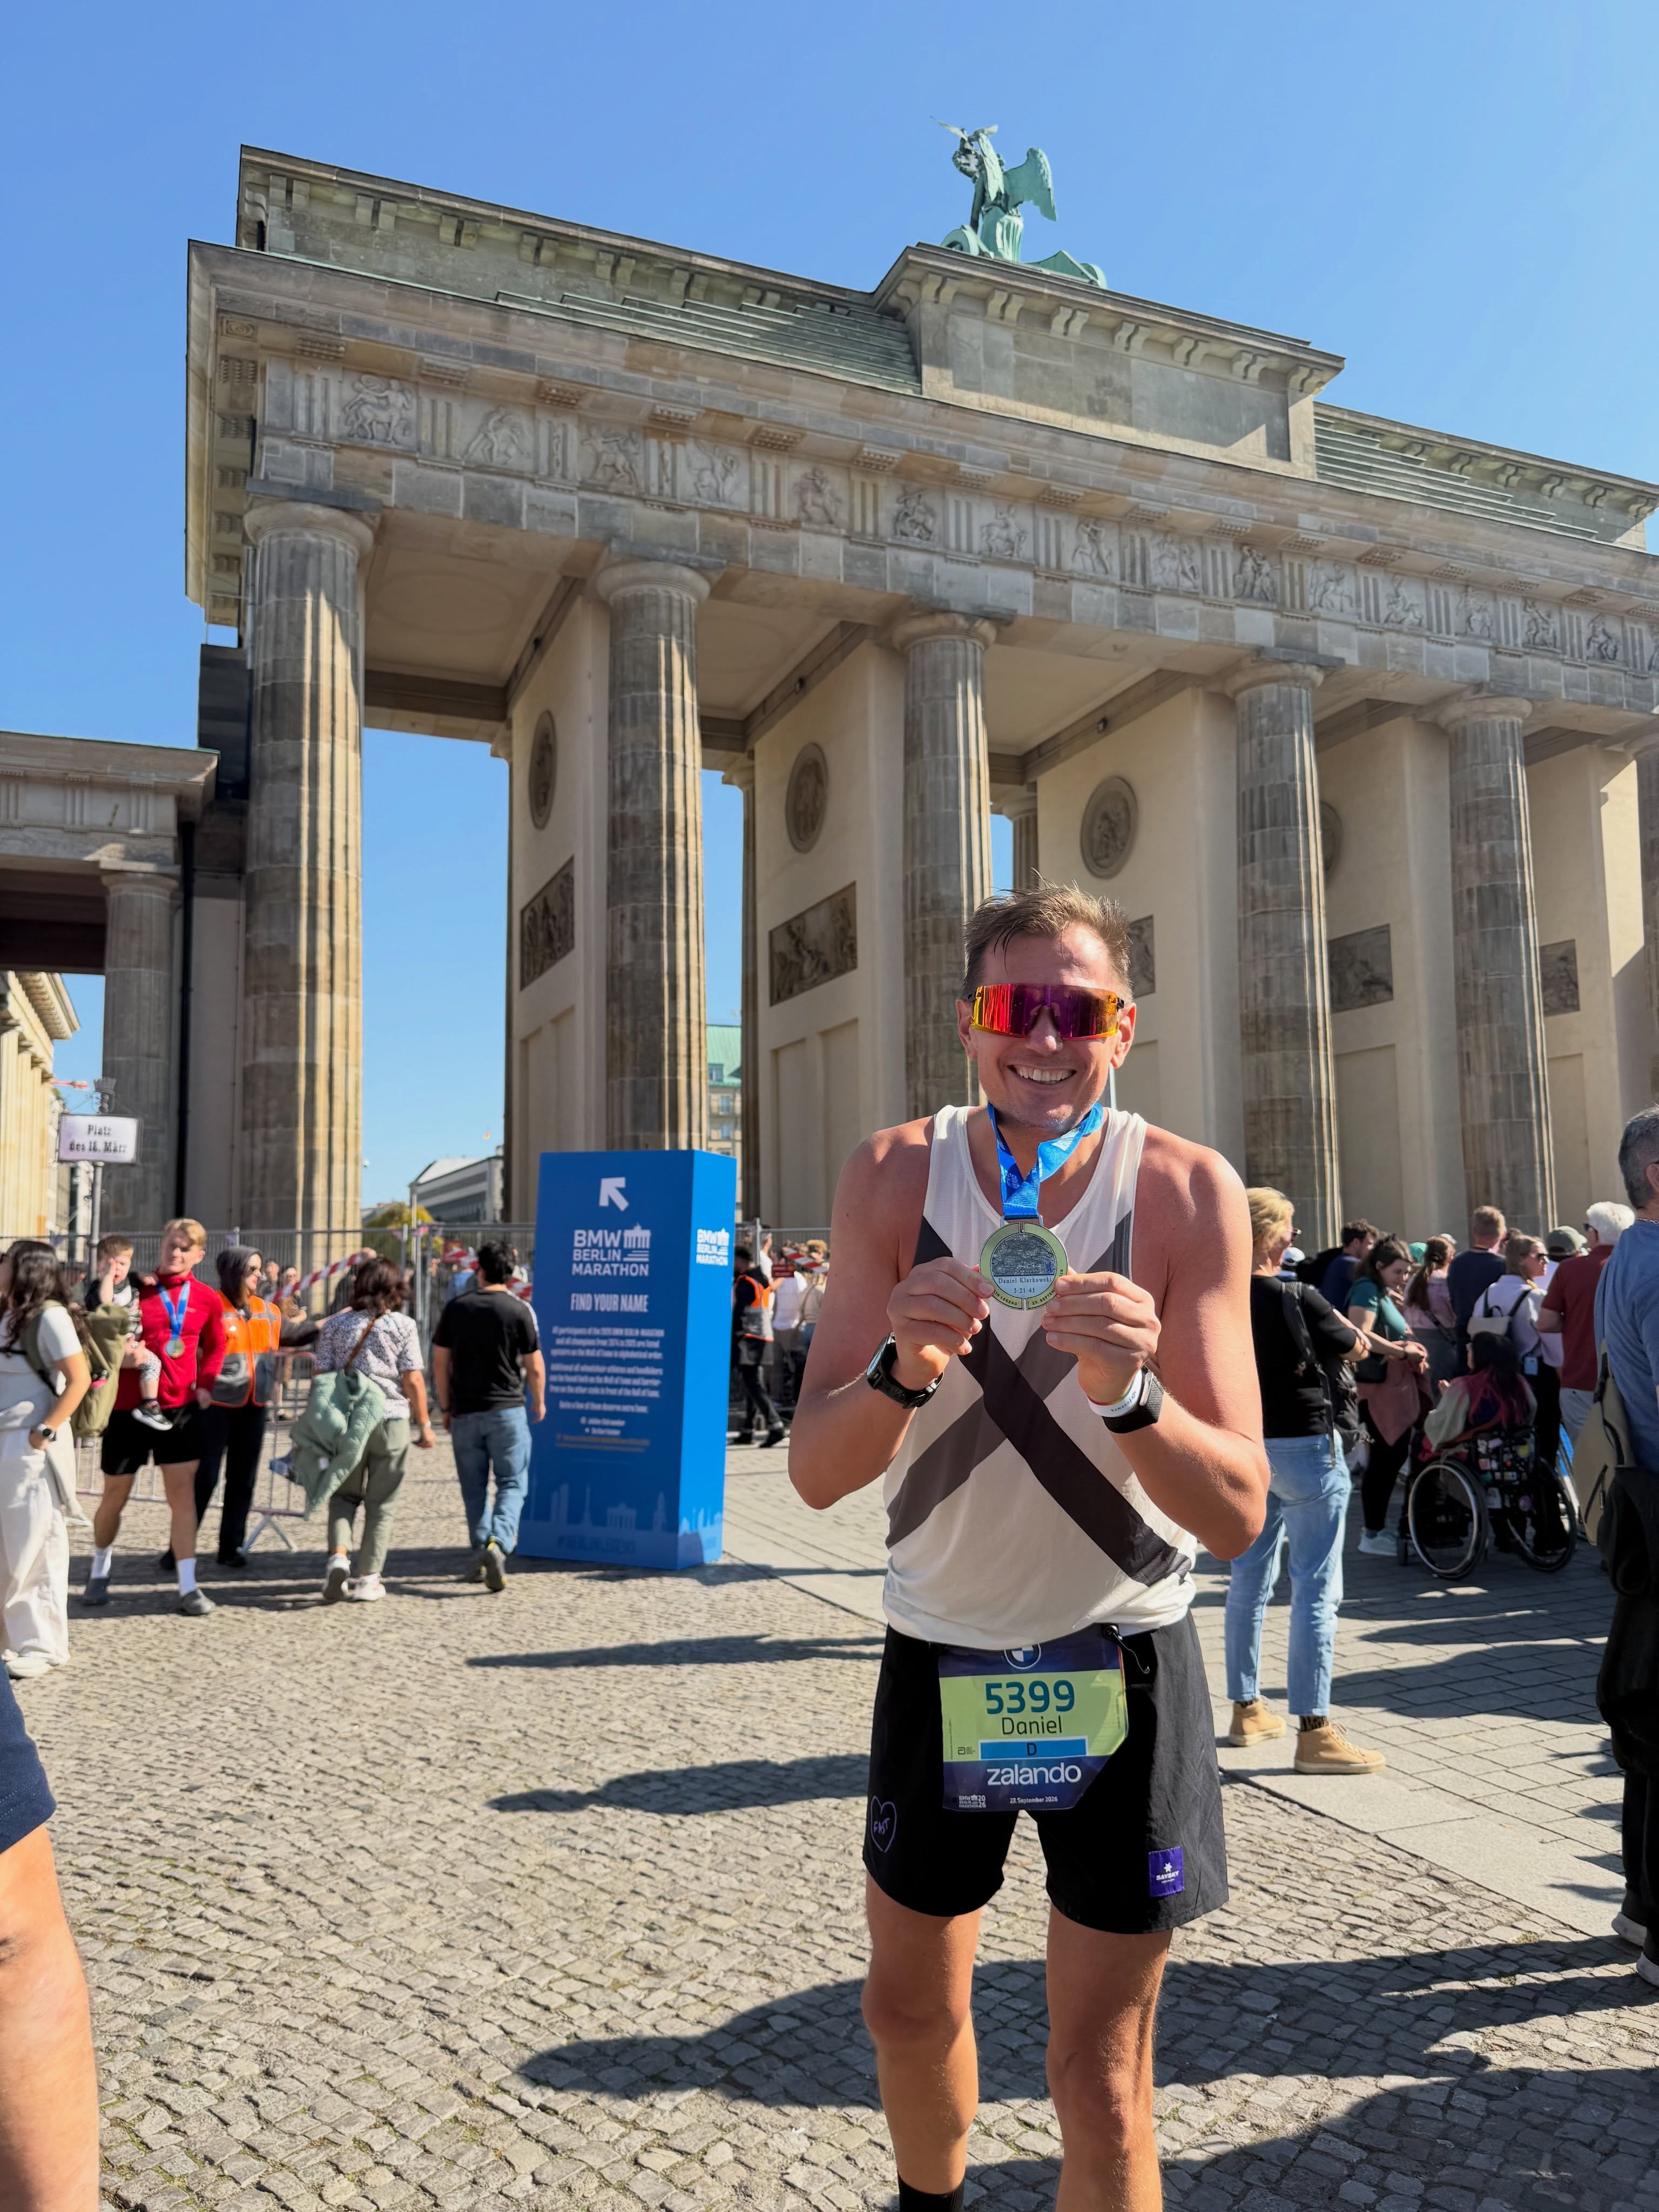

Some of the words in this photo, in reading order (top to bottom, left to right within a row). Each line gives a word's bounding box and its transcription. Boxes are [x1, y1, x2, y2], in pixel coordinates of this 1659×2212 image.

[87, 1124, 112, 1135] Platz
[69, 1139, 85, 1152] des
[574, 1229, 622, 1247] BMW
[573, 1249, 621, 1262] BERLIN
[572, 1263, 649, 1277] MARATHON
[570, 1293, 592, 1311] FIND
[595, 1294, 619, 1312] YOUR
[621, 1294, 649, 1313] NAME
[1000, 1296, 1017, 1305] LEGEND
[986, 1680, 1075, 1714] 5399
[1002, 1715, 1062, 1735] Daniel
[1027, 1743, 1037, 1756] D
[987, 1763, 1082, 1786] zalando
